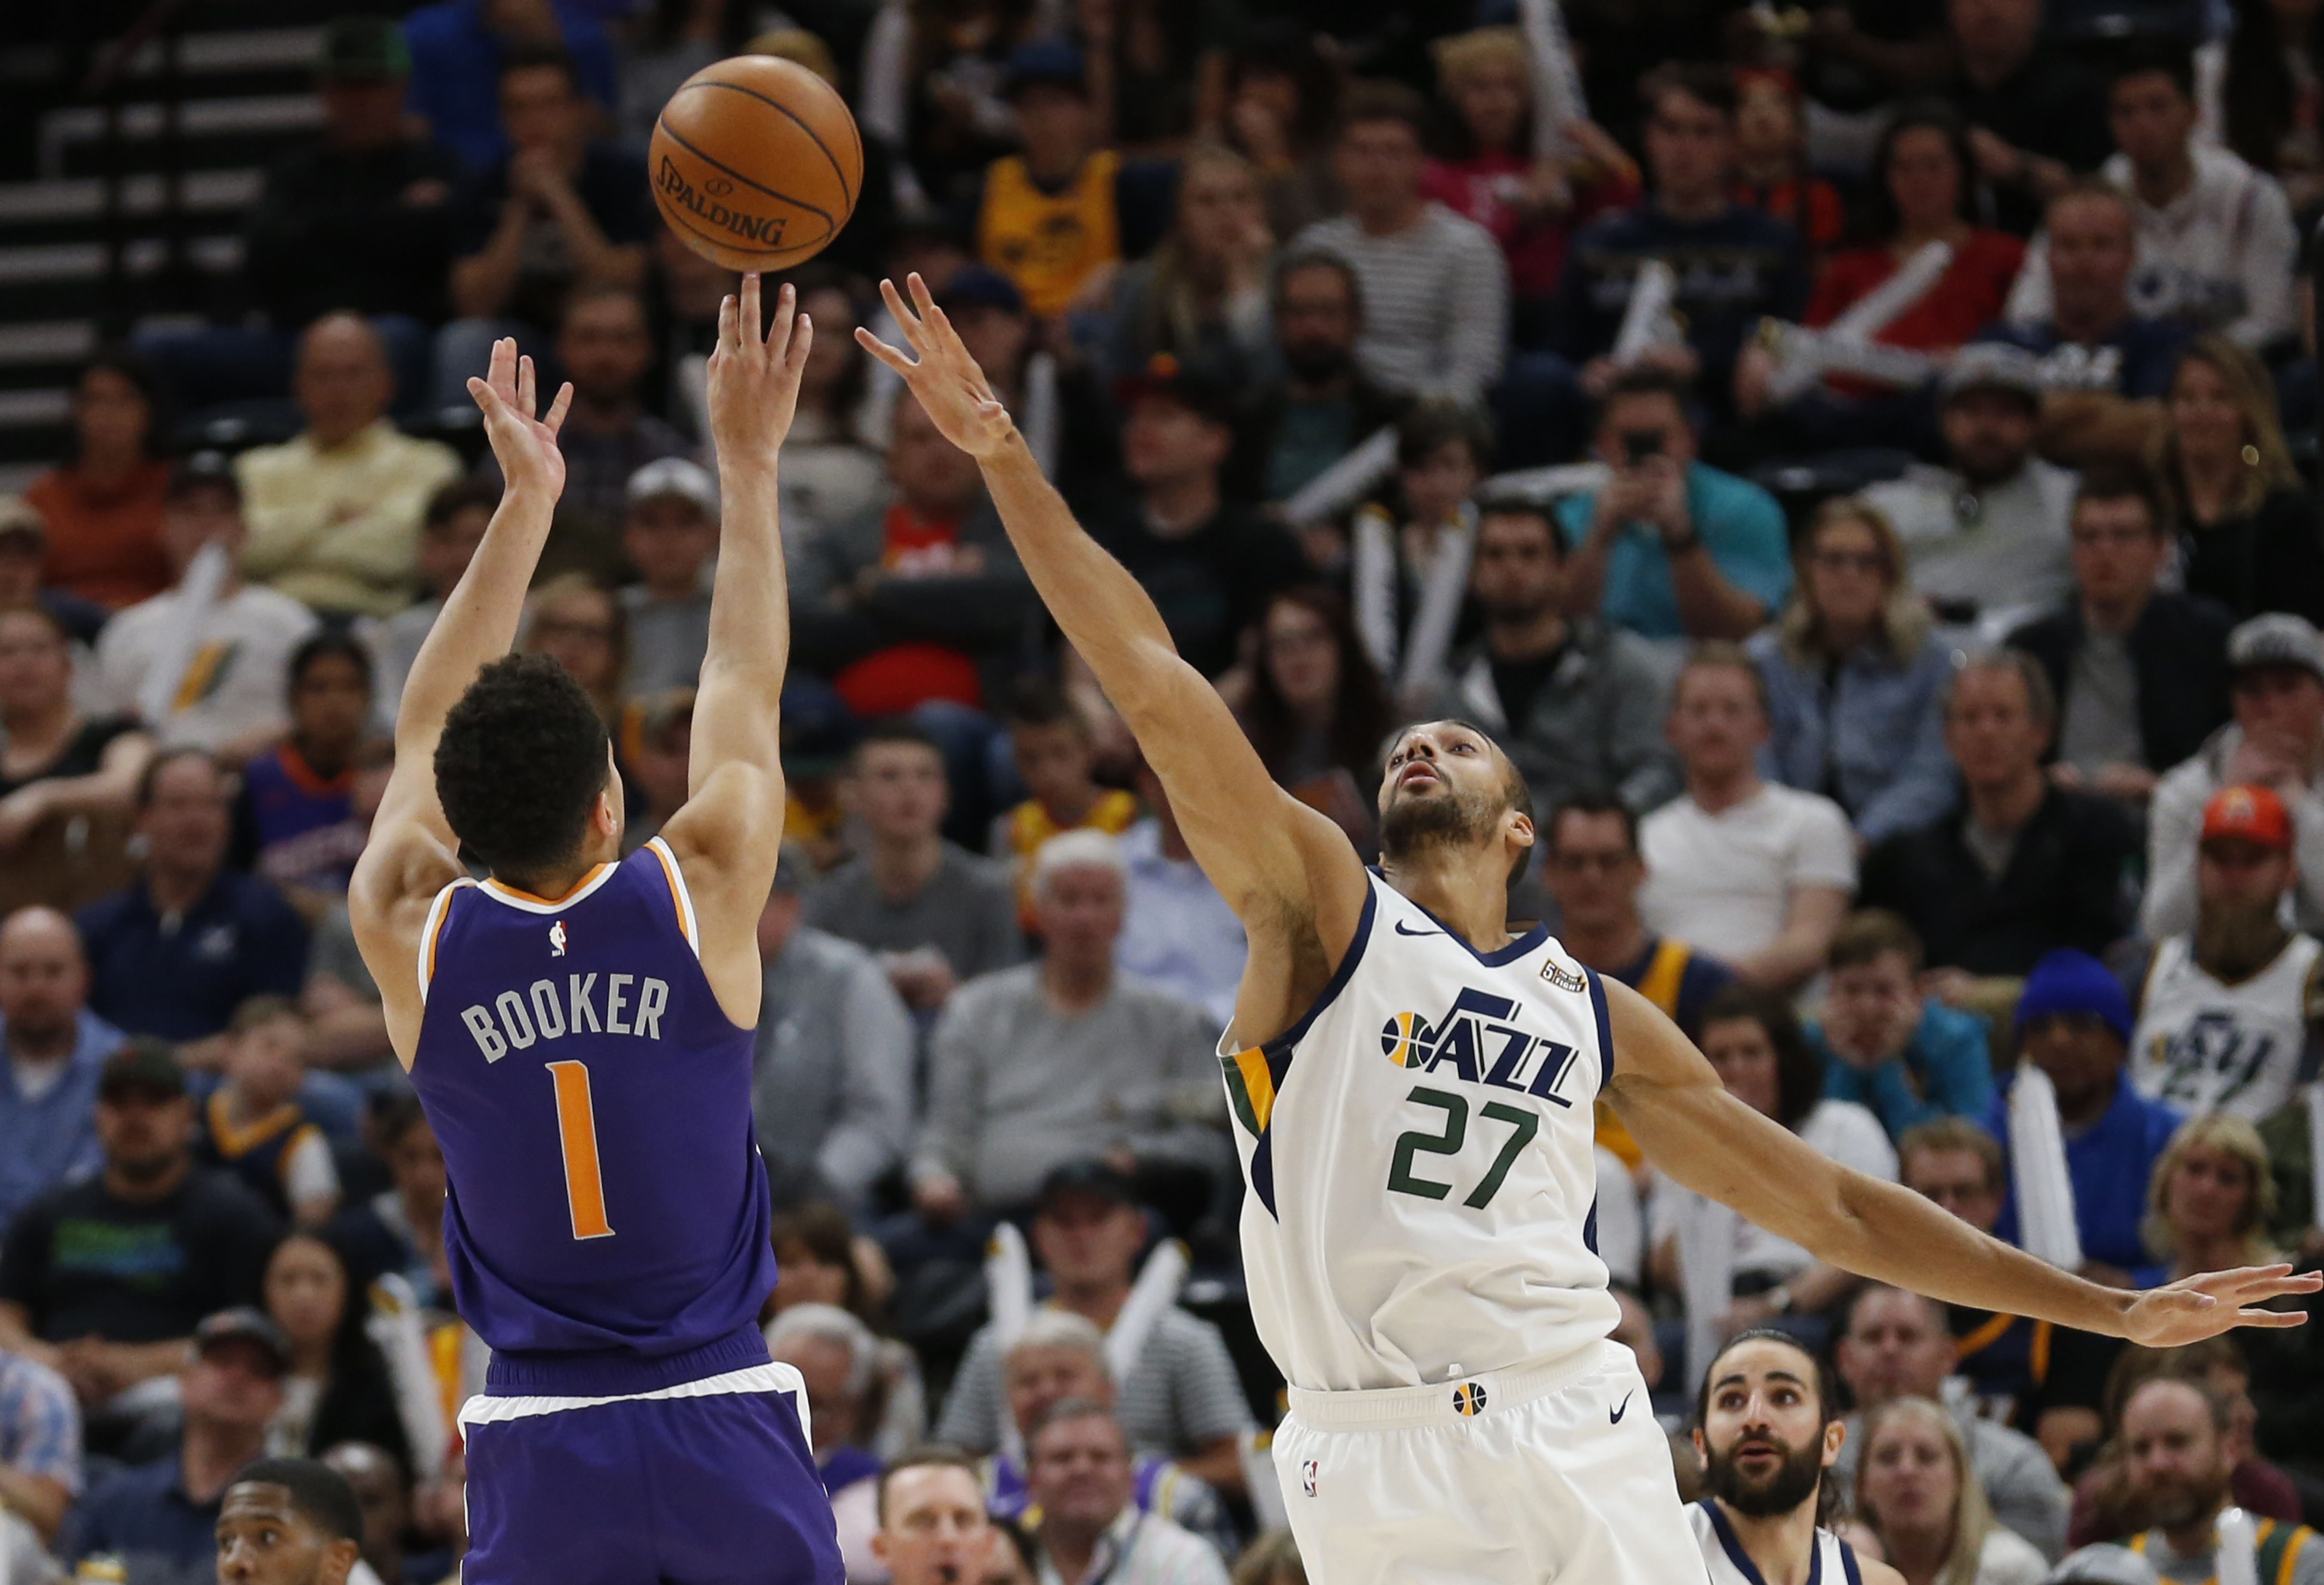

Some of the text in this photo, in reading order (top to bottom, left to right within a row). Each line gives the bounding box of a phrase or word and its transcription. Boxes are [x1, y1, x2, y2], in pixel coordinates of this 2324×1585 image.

[657, 155, 787, 246] SPALDING
[460, 972, 669, 1064] BOOKER
[1543, 962, 1556, 980] 5
[1381, 987, 1580, 1109] JAZZ
[545, 1059, 616, 1240] 1
[1387, 1086, 1539, 1210] 27
